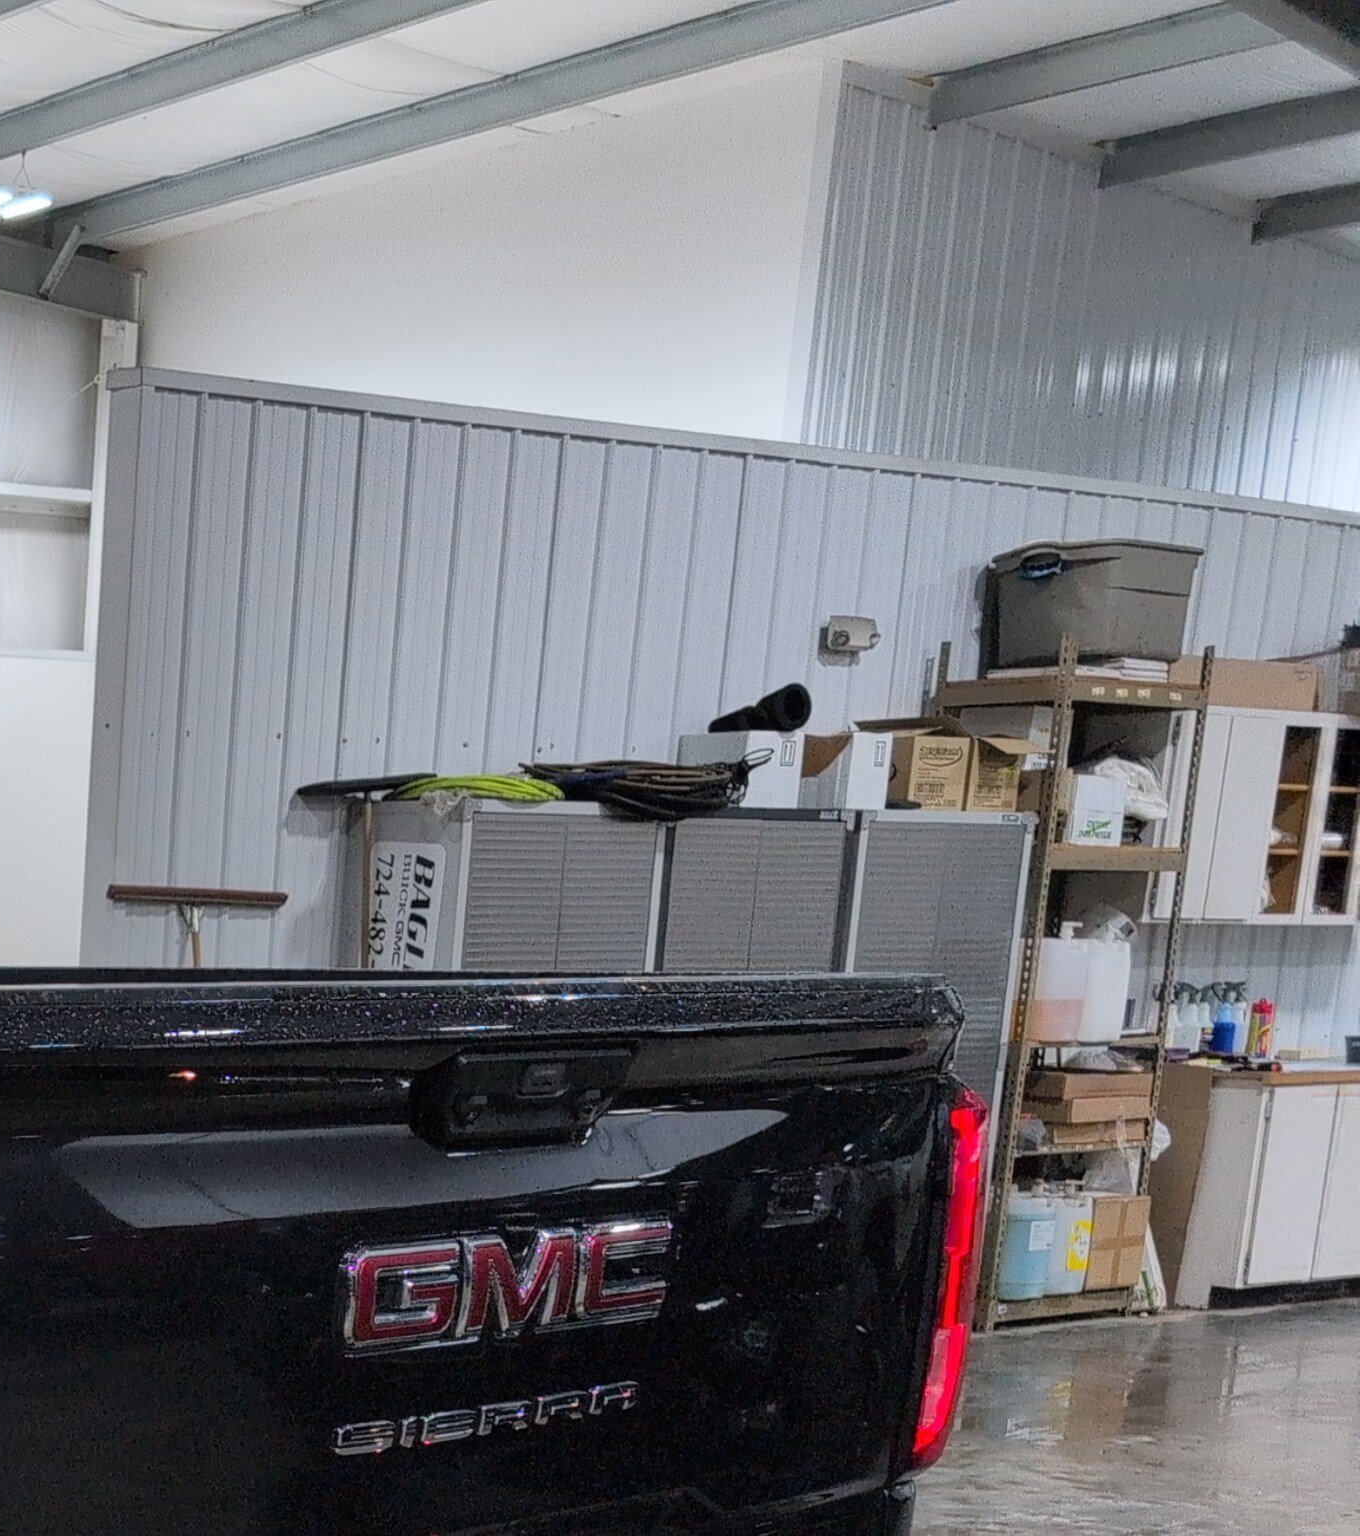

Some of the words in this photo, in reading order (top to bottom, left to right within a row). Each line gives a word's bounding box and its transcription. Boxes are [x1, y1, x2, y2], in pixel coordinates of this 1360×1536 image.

[398, 854, 412, 916] BUICK
[401, 855, 435, 969] BAGL
[391, 921, 405, 966] GMC
[340, 1215, 674, 1348] GMC
[332, 1380, 640, 1456] SIERRA
